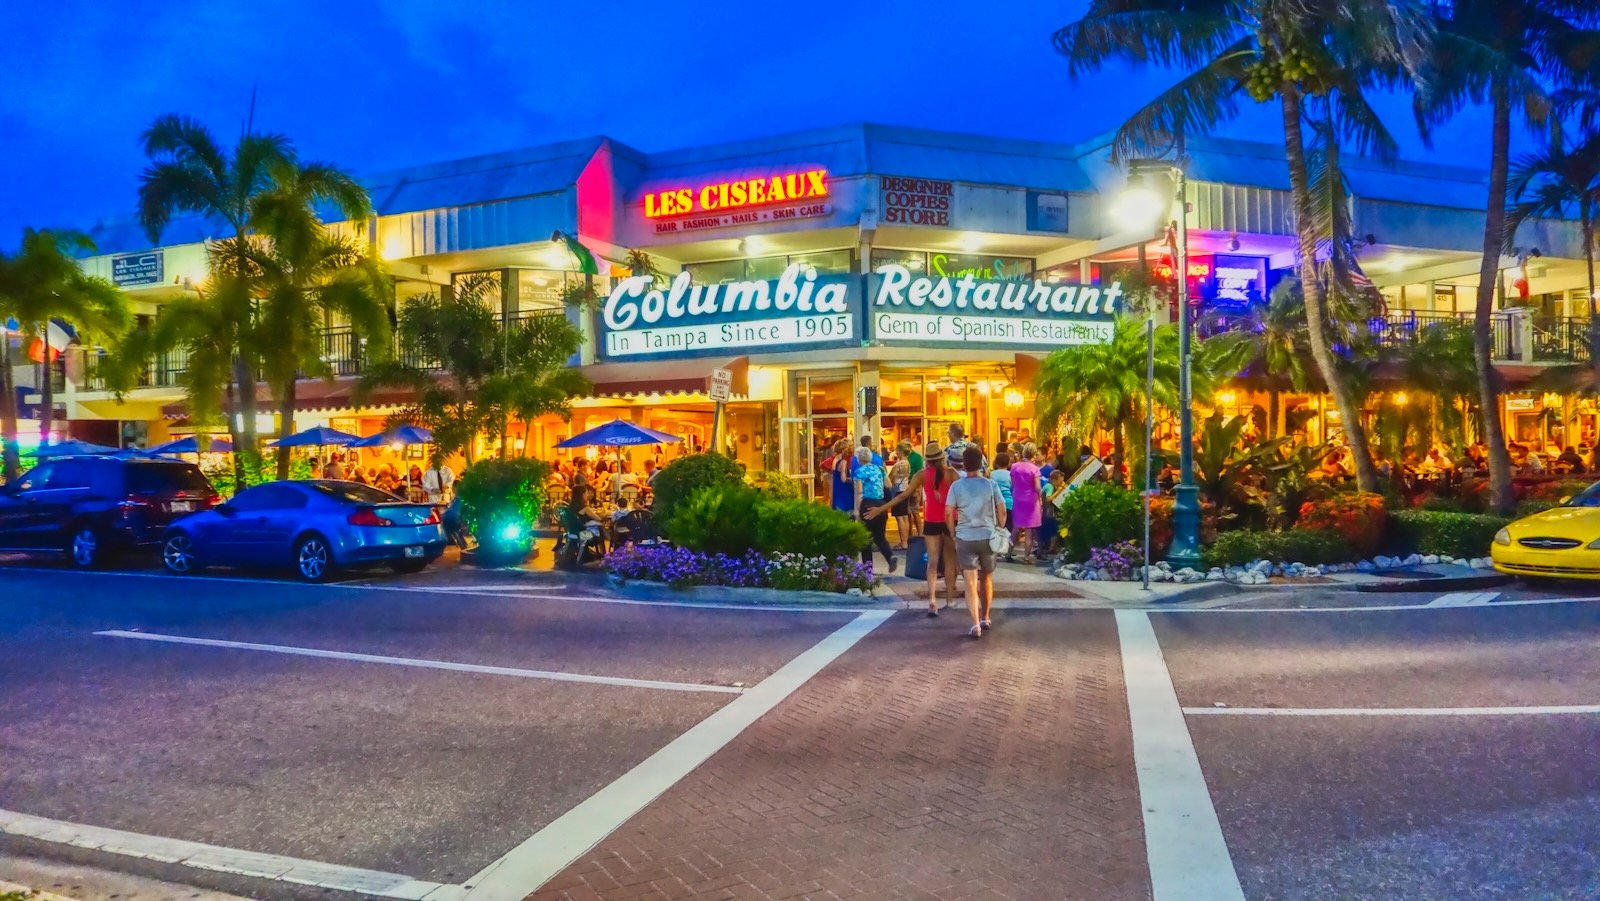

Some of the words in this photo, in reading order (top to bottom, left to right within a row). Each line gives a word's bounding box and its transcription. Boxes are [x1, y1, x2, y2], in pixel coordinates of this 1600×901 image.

[644, 187, 693, 217] LES
[699, 169, 828, 210] CISEAUX
[881, 176, 953, 196] DESIGNER
[885, 192, 949, 210] COPIES
[656, 222, 678, 232] HAIR
[683, 218, 720, 229] FASHION
[732, 212, 759, 223] NAILS
[773, 207, 796, 219] SKIN
[800, 204, 825, 216] CARE
[885, 207, 949, 226] STORE
[603, 263, 848, 331] Columbia
[876, 264, 1123, 315] Restaurant
[612, 333, 630, 351] In
[642, 330, 707, 350] Tampa
[721, 323, 780, 342] Since
[794, 316, 848, 338] 1905
[878, 314, 918, 334] Gem
[926, 315, 943, 335] of
[952, 316, 1016, 341] Spanish
[1022, 320, 1109, 342] Restaurants
